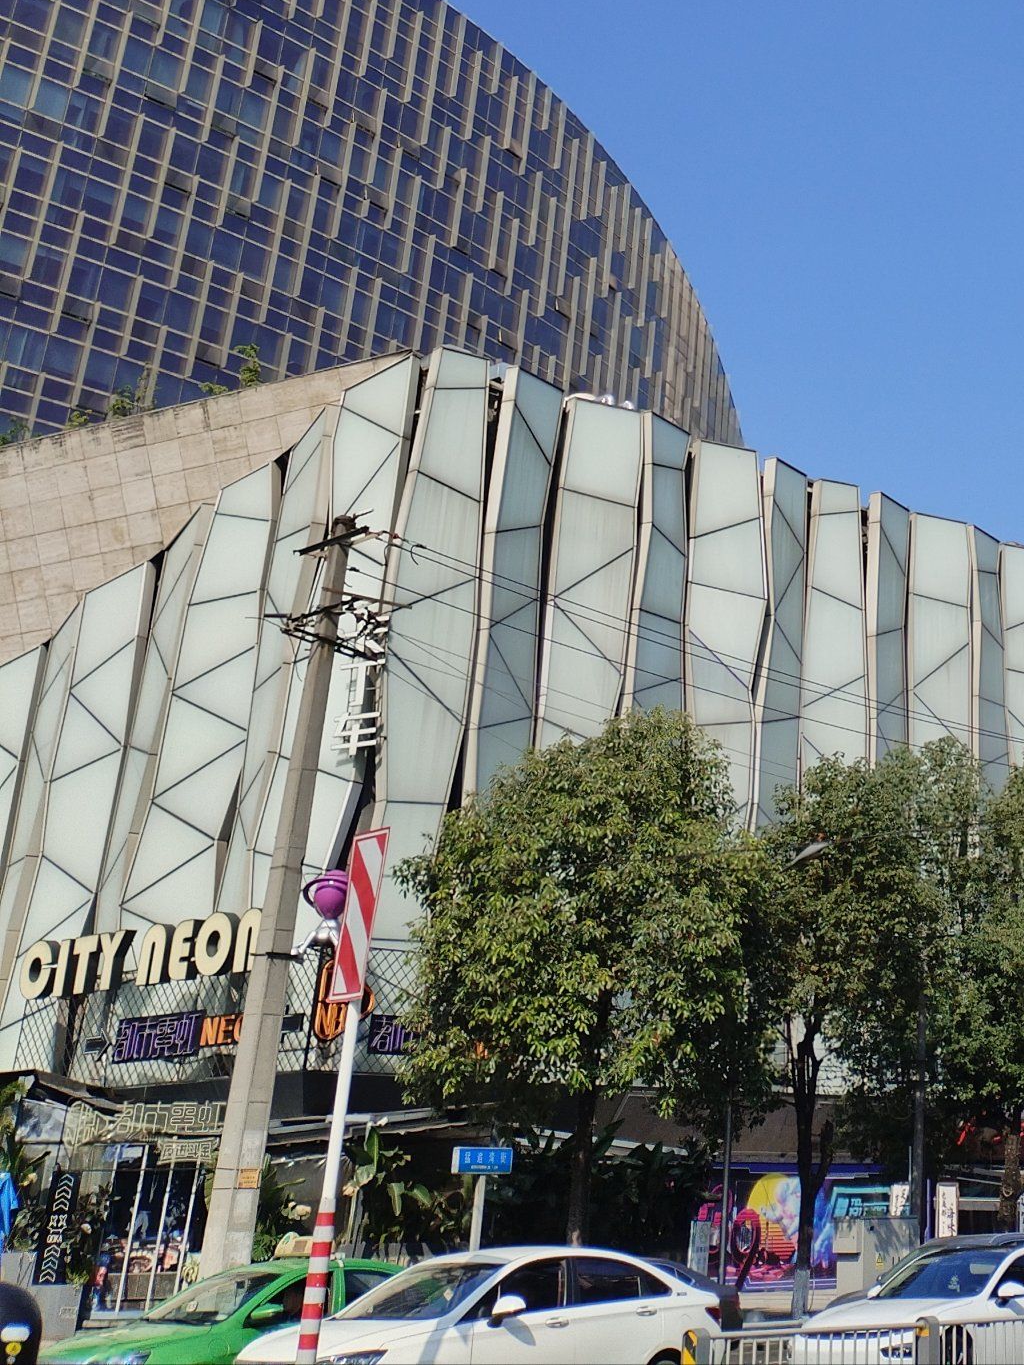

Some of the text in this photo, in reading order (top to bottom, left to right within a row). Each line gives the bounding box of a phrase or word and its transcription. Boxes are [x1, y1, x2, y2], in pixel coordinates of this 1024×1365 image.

[19, 930, 132, 1000] CITY
[113, 1013, 201, 1062] 都市霓虹
[116, 1099, 228, 1133] 都市霓虹
